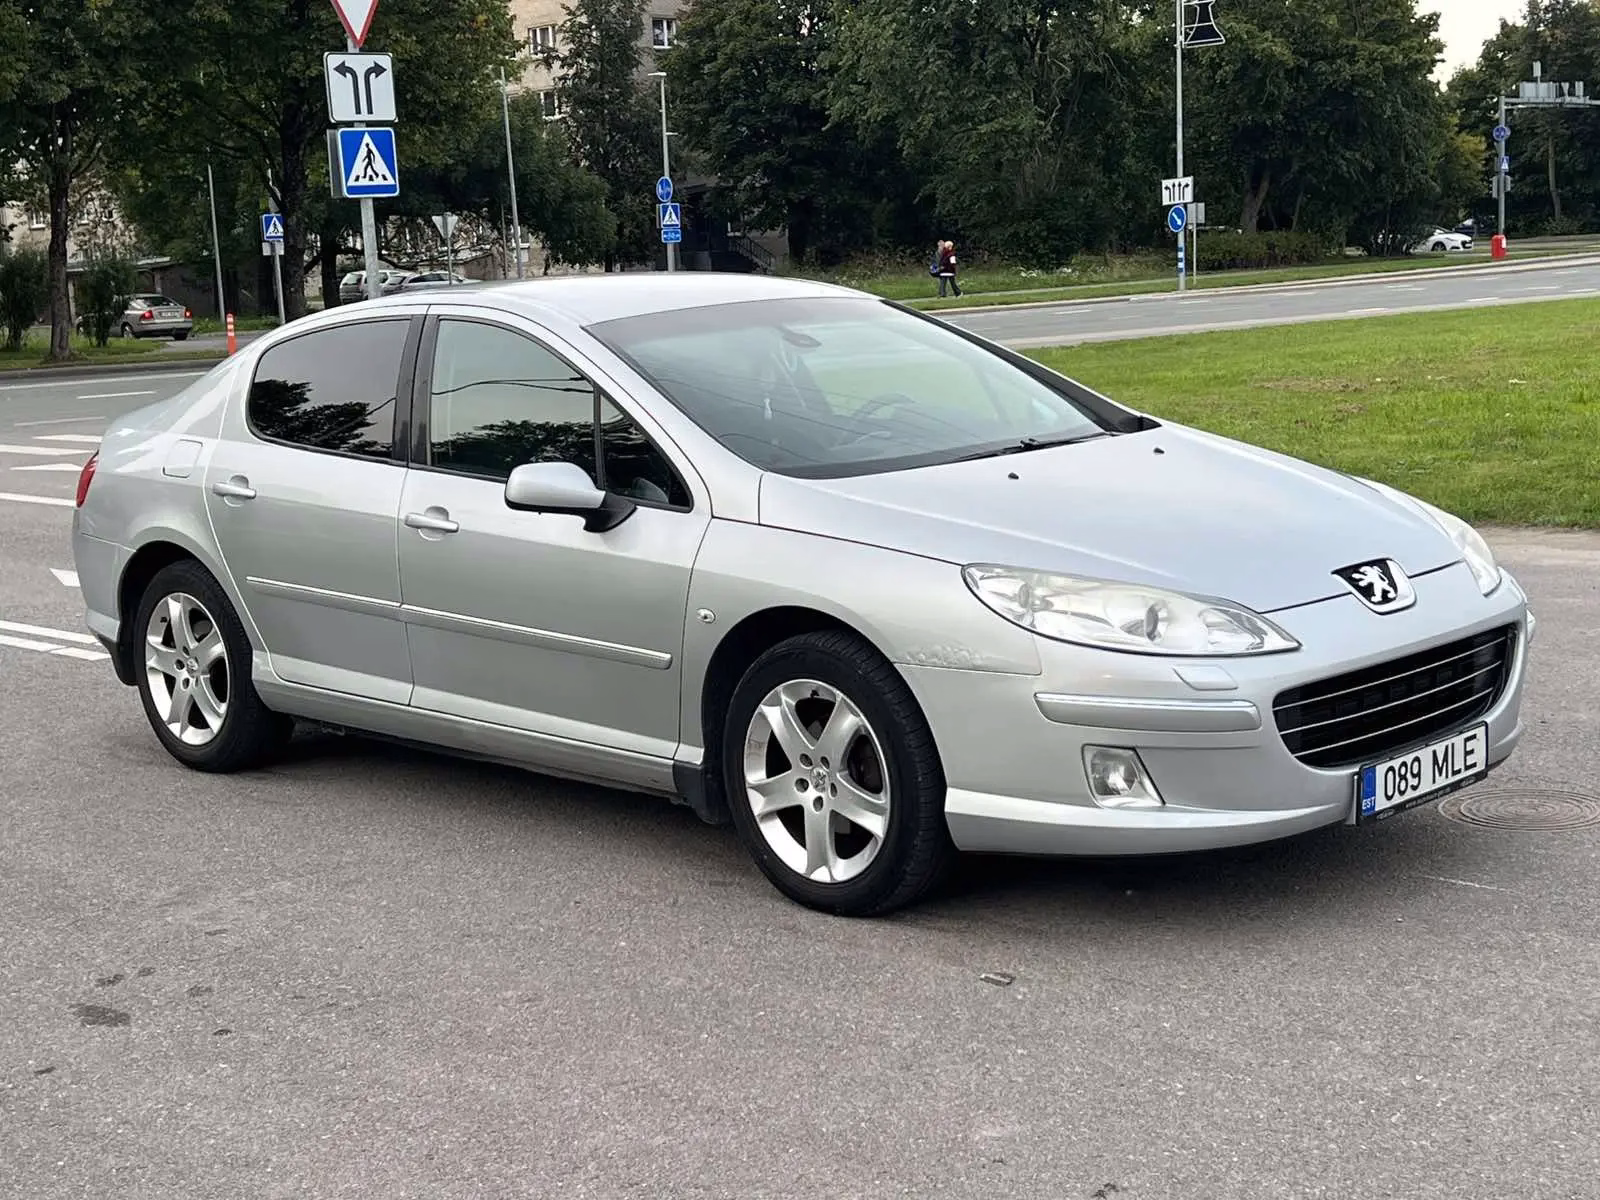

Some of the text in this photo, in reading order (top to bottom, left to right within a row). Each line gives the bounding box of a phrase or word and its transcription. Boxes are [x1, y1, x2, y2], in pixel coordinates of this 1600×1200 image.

[1384, 756, 1422, 801] 089
[1432, 733, 1478, 785] MLE
[1361, 796, 1377, 810] EST
